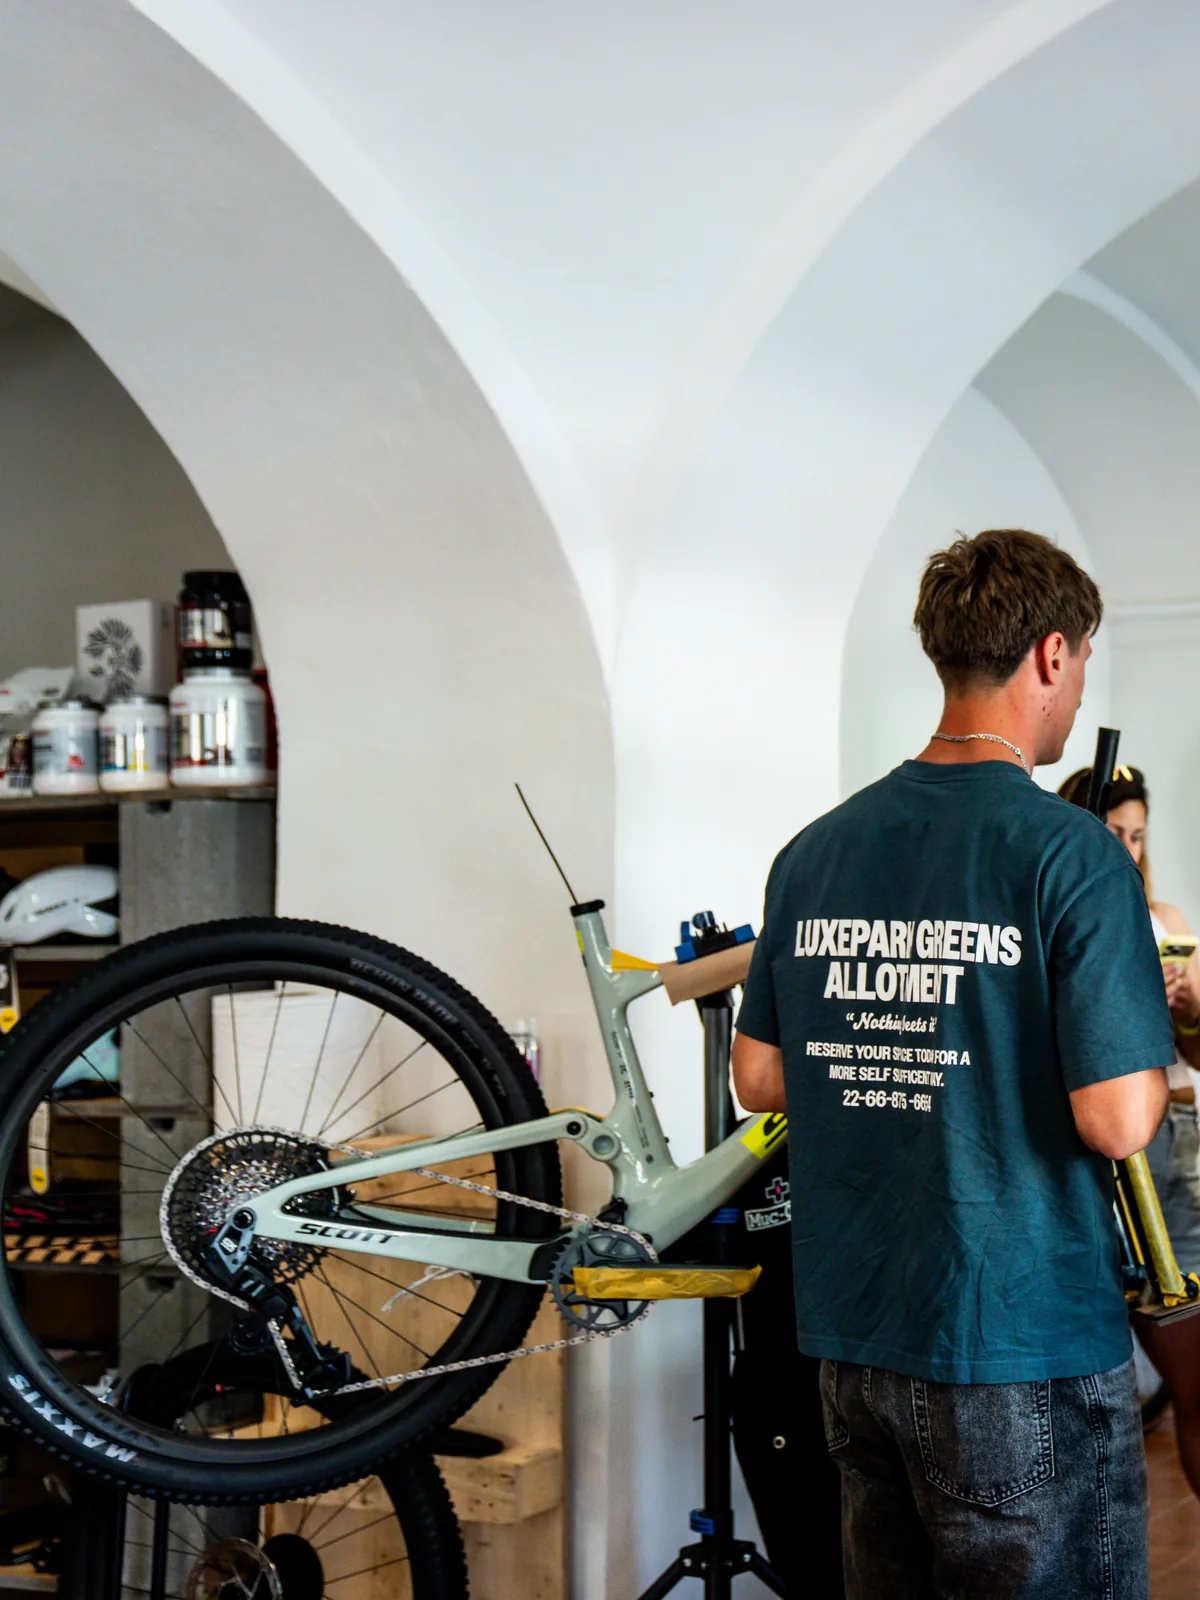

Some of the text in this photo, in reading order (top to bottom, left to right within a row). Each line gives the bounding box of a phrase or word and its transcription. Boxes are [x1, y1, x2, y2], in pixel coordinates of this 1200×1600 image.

[916, 919, 1022, 966] GREENS
[806, 1041, 853, 1059] RESERVE
[855, 1045, 891, 1061] YOUR
[934, 1050, 958, 1065] FOR
[959, 1051, 971, 1066] A
[829, 1064, 857, 1081] MORE
[858, 1066, 891, 1082] SELF
[295, 1223, 399, 1244] SCOTT
[8, 1374, 138, 1463] MAXXIS
